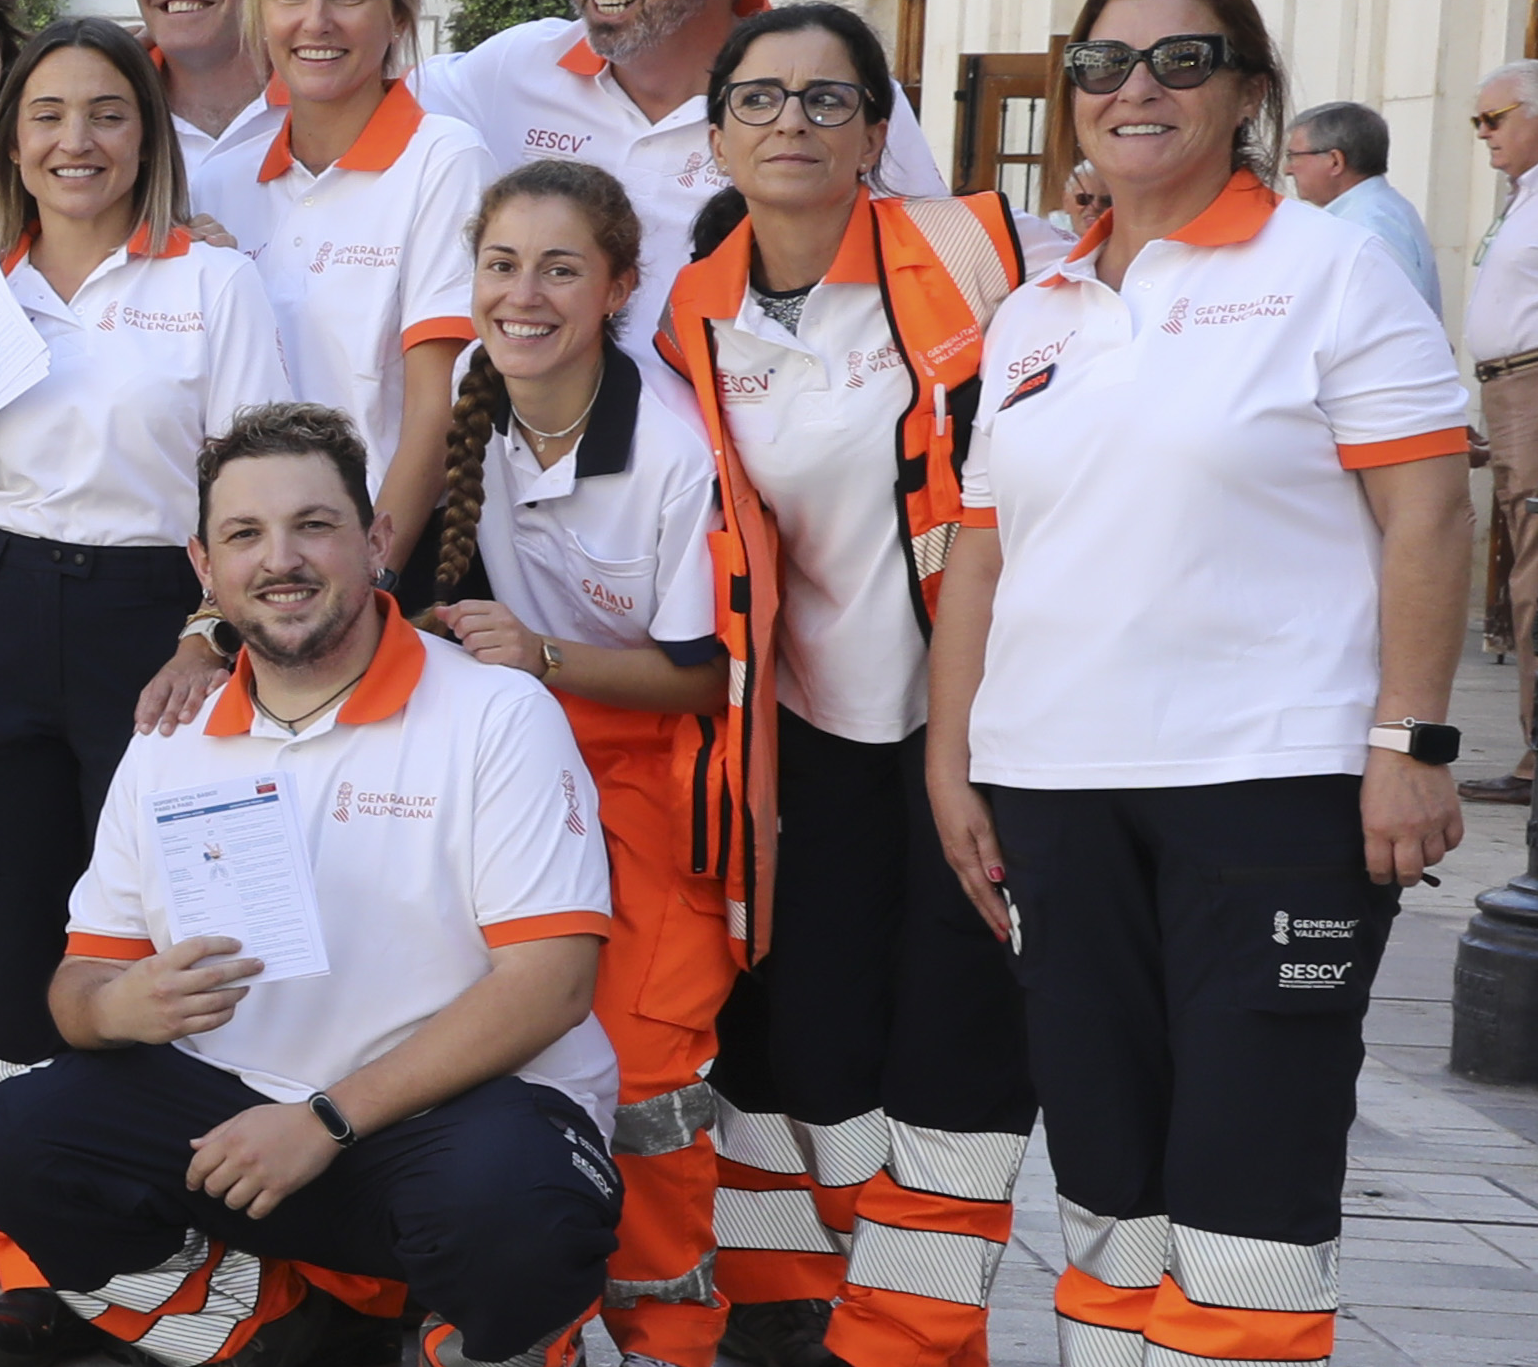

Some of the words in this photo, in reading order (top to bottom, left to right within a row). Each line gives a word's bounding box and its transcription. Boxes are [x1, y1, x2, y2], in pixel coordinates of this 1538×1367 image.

[525, 128, 584, 153] SESCV
[1195, 295, 1294, 315] GENERALITAT
[123, 307, 204, 322] GENERALITAT
[1194, 307, 1286, 325] VALENCIANA
[123, 317, 205, 333] VALENCIANA
[1007, 339, 1068, 380] SESCV
[717, 374, 768, 393] ESCV
[582, 579, 634, 610] SAMU
[357, 792, 437, 807] GENERALITAT
[357, 804, 433, 819] VALENCIANA
[1279, 963, 1347, 979] SESCV
